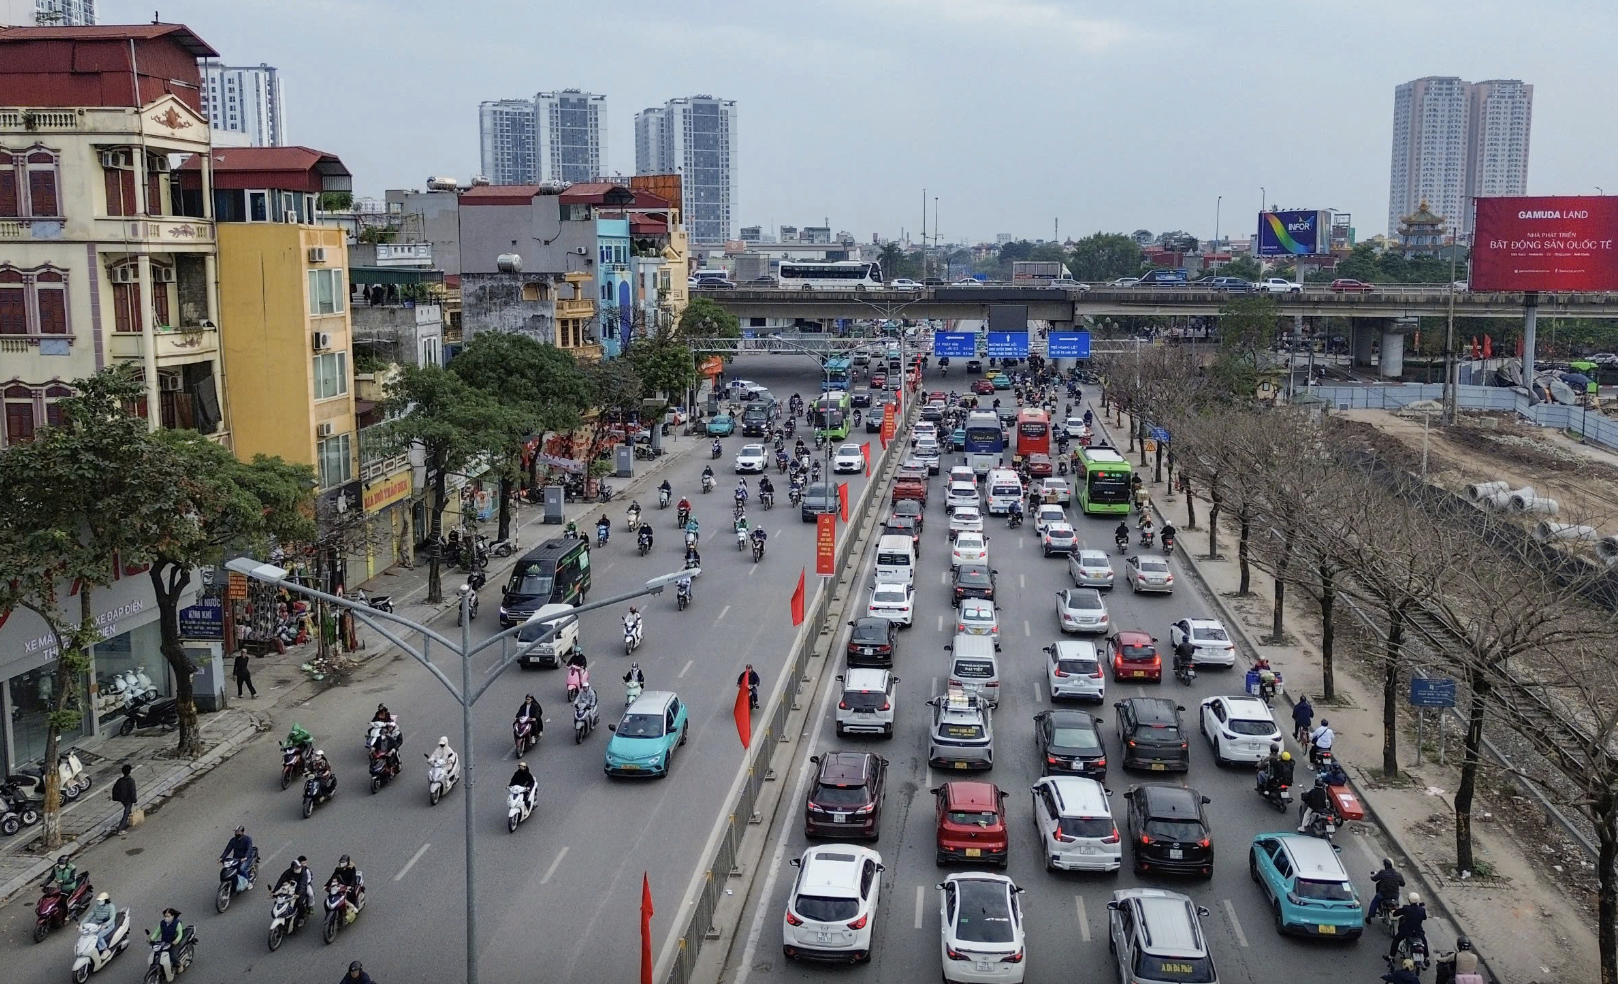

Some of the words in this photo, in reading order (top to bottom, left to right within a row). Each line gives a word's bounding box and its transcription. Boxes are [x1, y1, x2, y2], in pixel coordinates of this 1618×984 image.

[1518, 210, 1560, 219] GAMUDA
[1563, 210, 1588, 219] LAND
[1490, 239, 1508, 249] BẤT
[1511, 239, 1541, 250] ĐỘNG
[1544, 239, 1564, 249] SẢN
[1567, 239, 1597, 250] QUỐC
[1600, 239, 1612, 249] TẾ
[25, 640, 37, 653] XE
[95, 614, 106, 625] XE
[107, 607, 124, 621] ĐẠP
[125, 599, 142, 614] ĐIỆN
